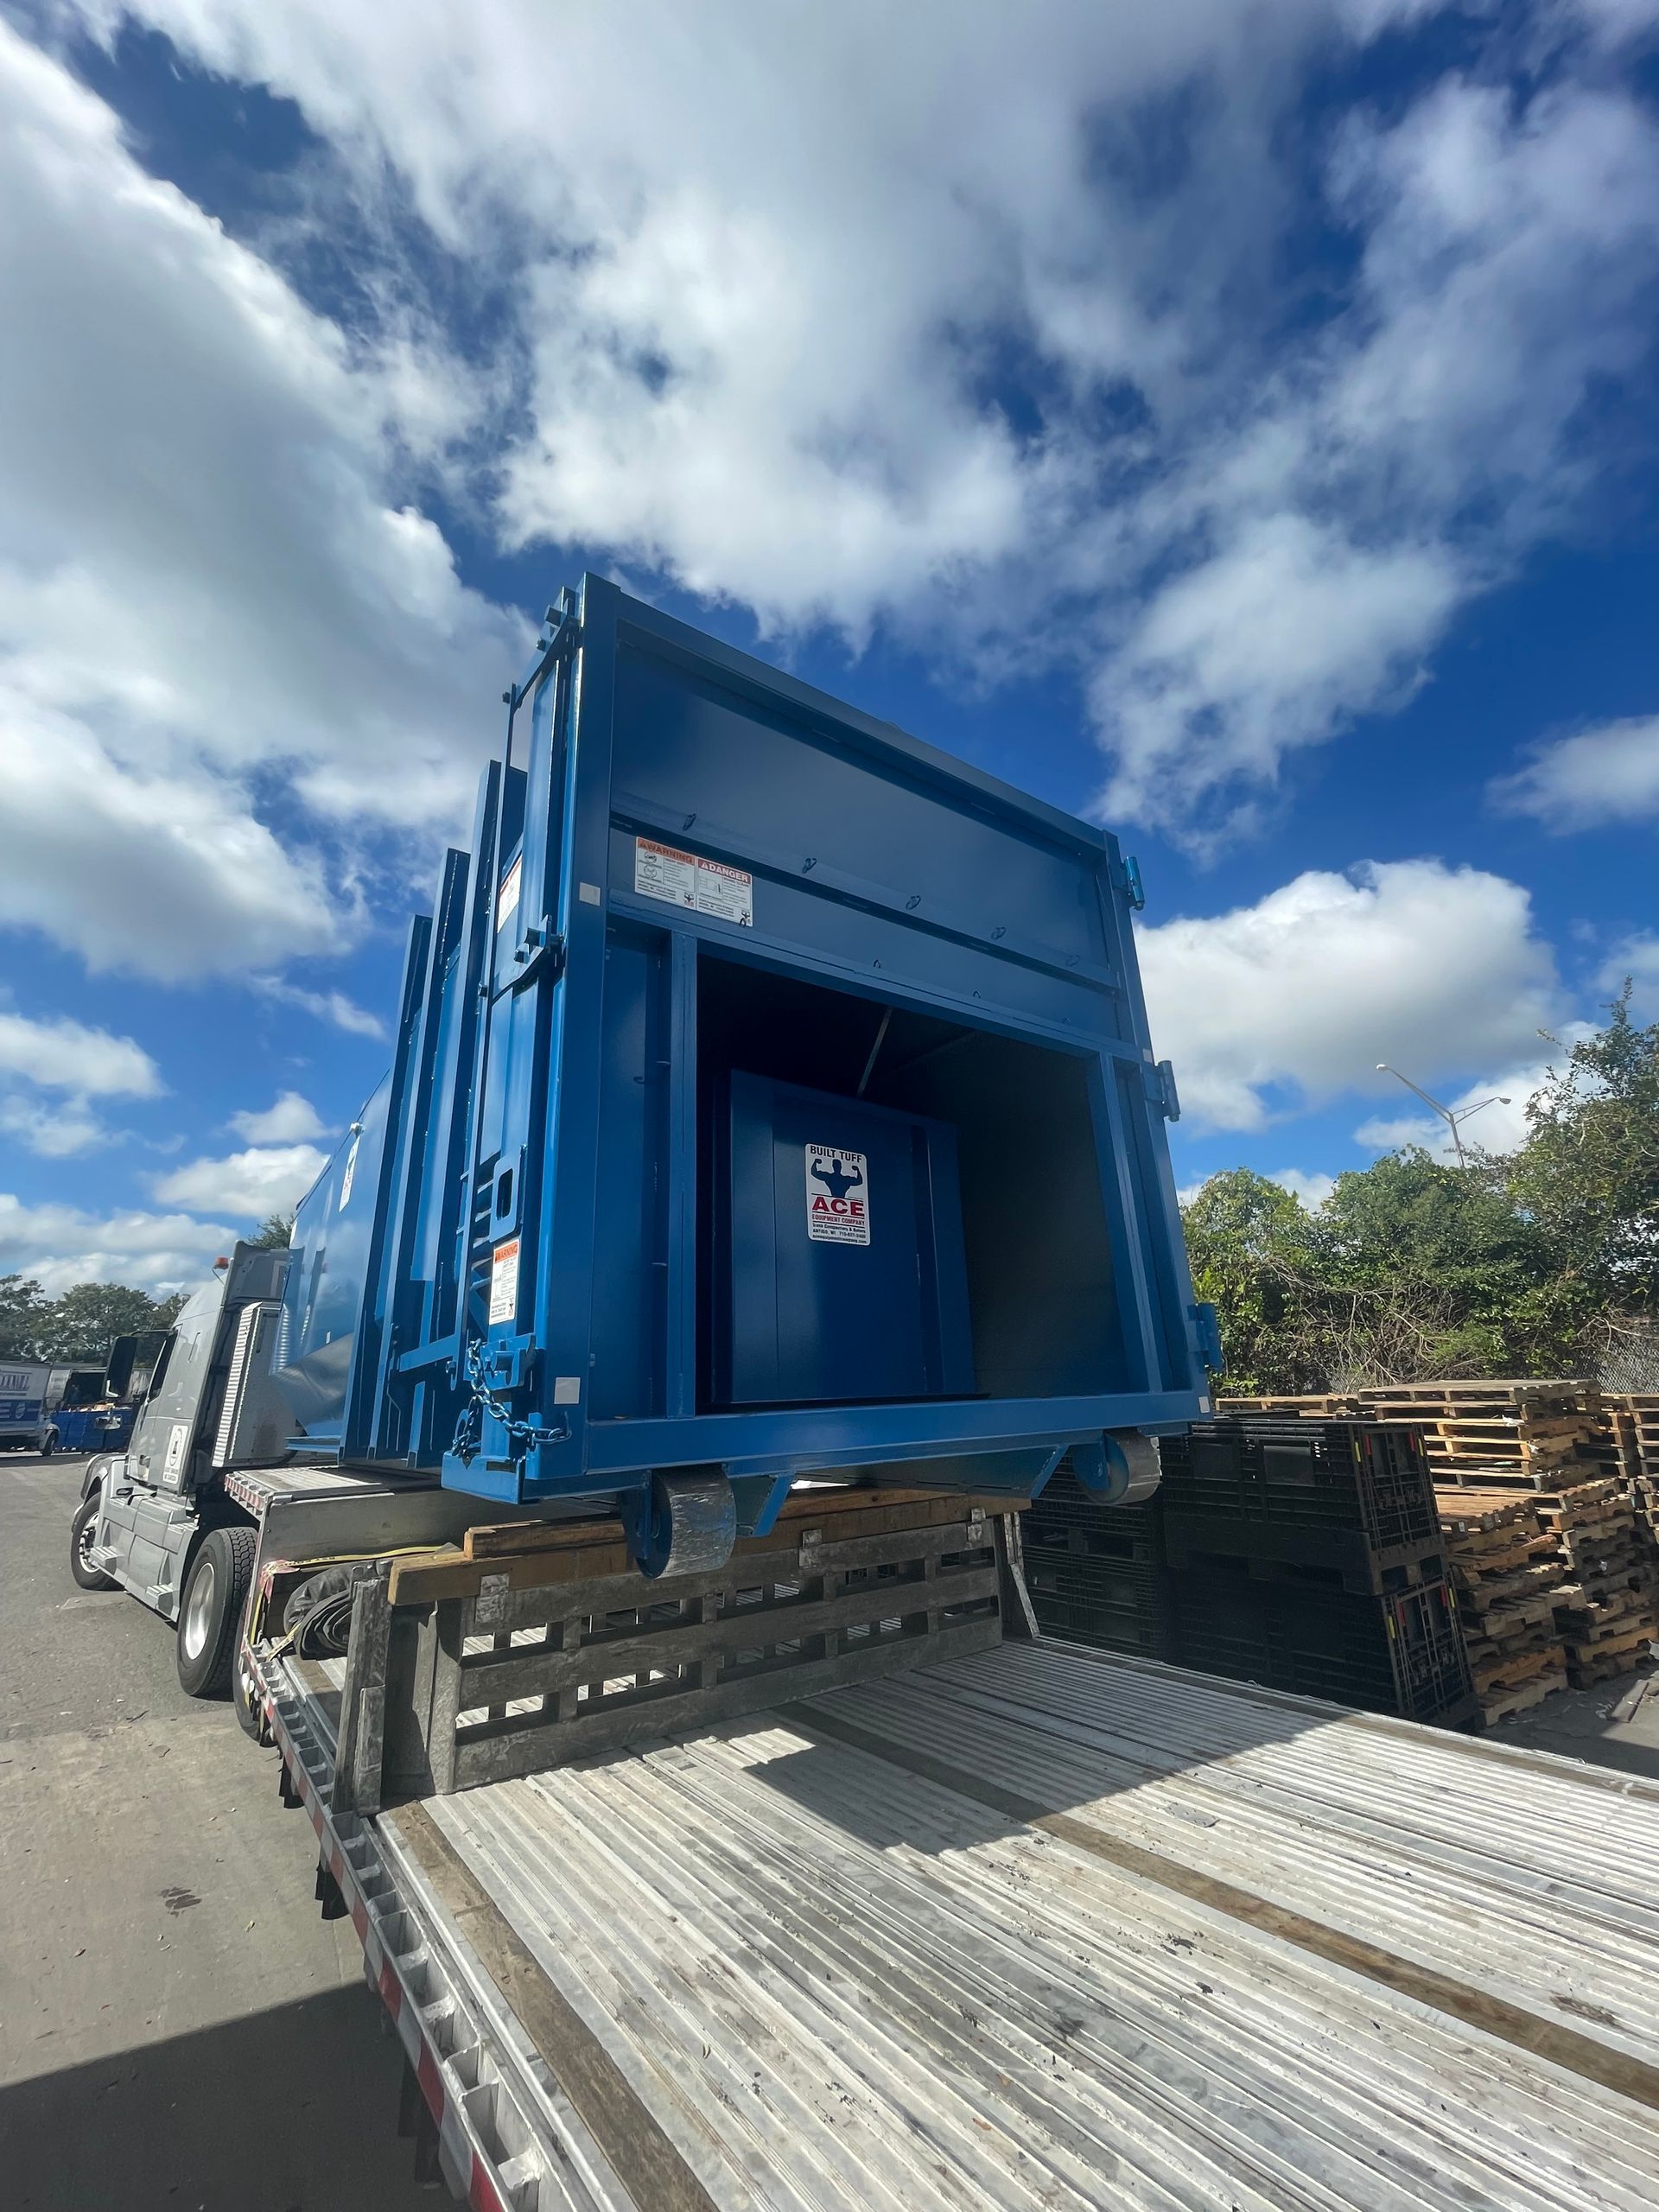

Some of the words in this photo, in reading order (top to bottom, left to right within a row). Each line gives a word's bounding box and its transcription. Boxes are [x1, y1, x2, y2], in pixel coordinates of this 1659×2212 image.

[647, 842, 693, 863] WARNING
[709, 863, 748, 882] DANGER
[810, 1146, 836, 1158] BUILT
[840, 1151, 862, 1163] TUFF
[812, 1197, 865, 1217] ACE
[812, 1213, 841, 1224] EQUIPMENT
[842, 1217, 865, 1226] COMPANY
